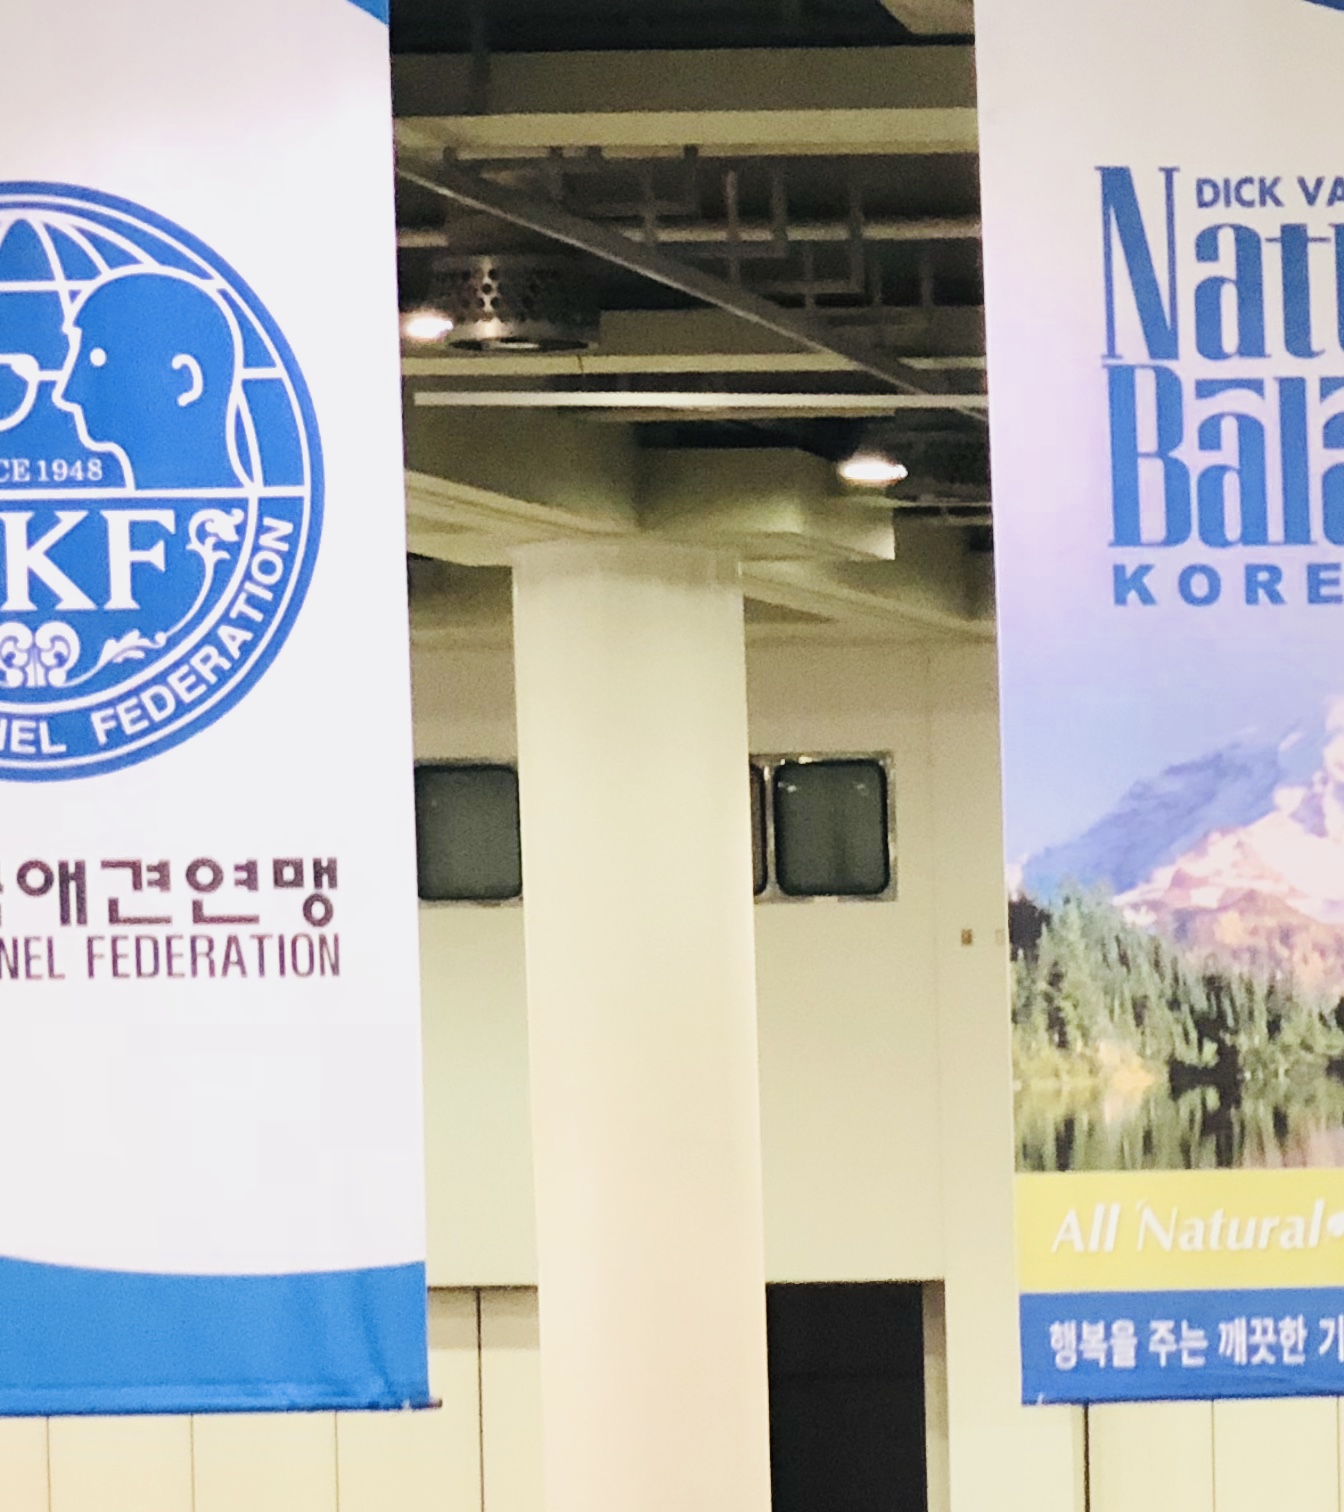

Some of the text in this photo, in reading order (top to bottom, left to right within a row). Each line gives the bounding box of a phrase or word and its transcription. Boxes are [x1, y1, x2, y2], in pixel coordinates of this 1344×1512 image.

[1196, 175, 1285, 210] DICK
[37, 459, 103, 482] 1948
[90, 516, 294, 746] FEDERATION
[0, 857, 338, 928] 애견연맹
[87, 933, 341, 980] FEDERATION
[1050, 1201, 1120, 1254] All
[1135, 1199, 1325, 1252] Natural
[1049, 1317, 1140, 1370] 행복을
[1148, 1315, 1209, 1368] 주는
[1217, 1314, 1309, 1366] 깨끗한
